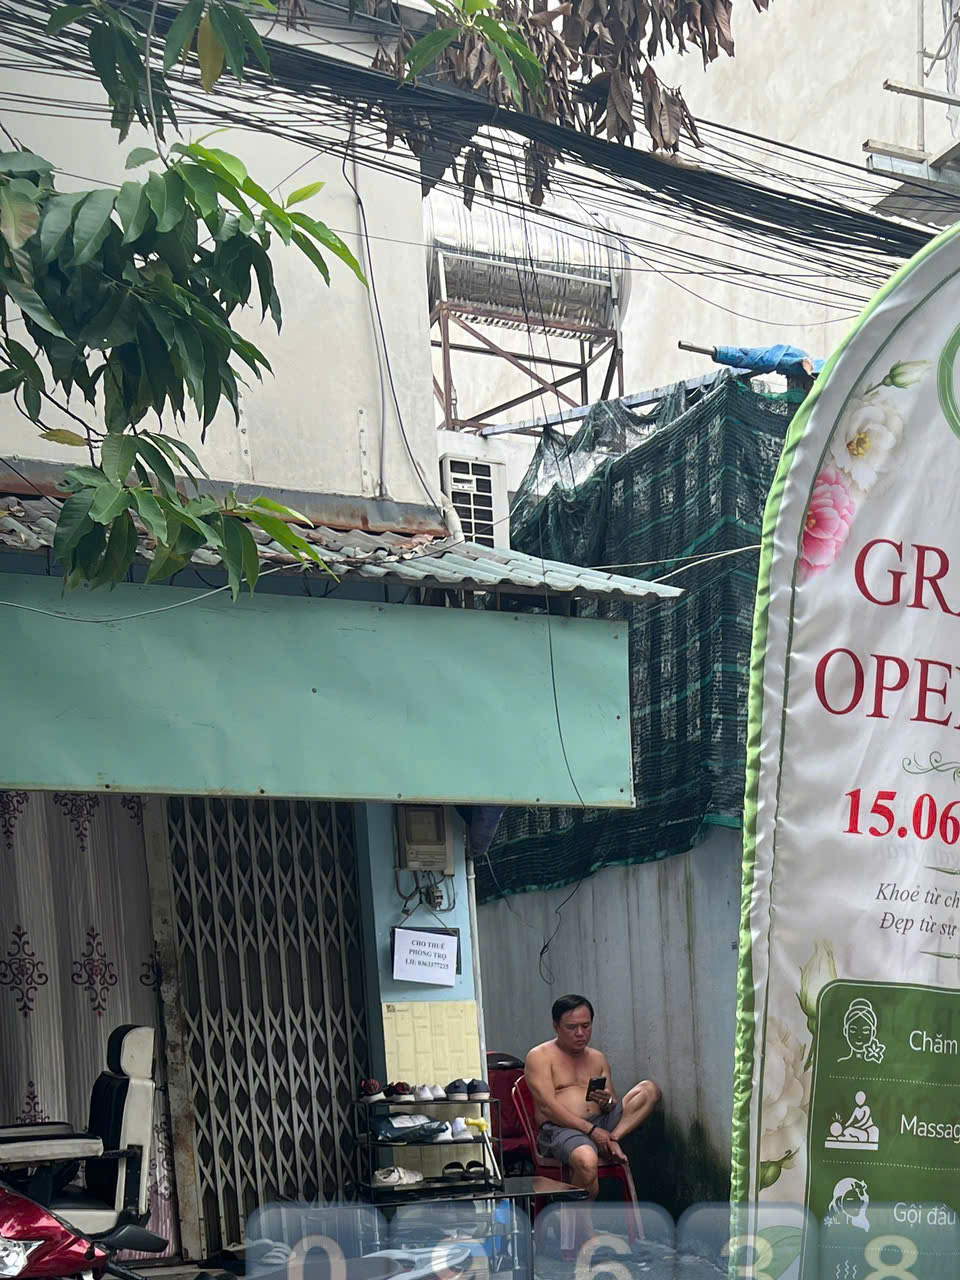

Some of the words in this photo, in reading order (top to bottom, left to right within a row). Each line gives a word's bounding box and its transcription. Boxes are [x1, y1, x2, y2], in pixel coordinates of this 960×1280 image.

[924, 886, 942, 905] từ
[879, 912, 914, 935] Đẹp
[919, 915, 937, 934] từ
[939, 920, 957, 940] sự
[909, 1030, 958, 1055] Chăm
[894, 1202, 922, 1227] Gội
[927, 1202, 956, 1226] đầu
